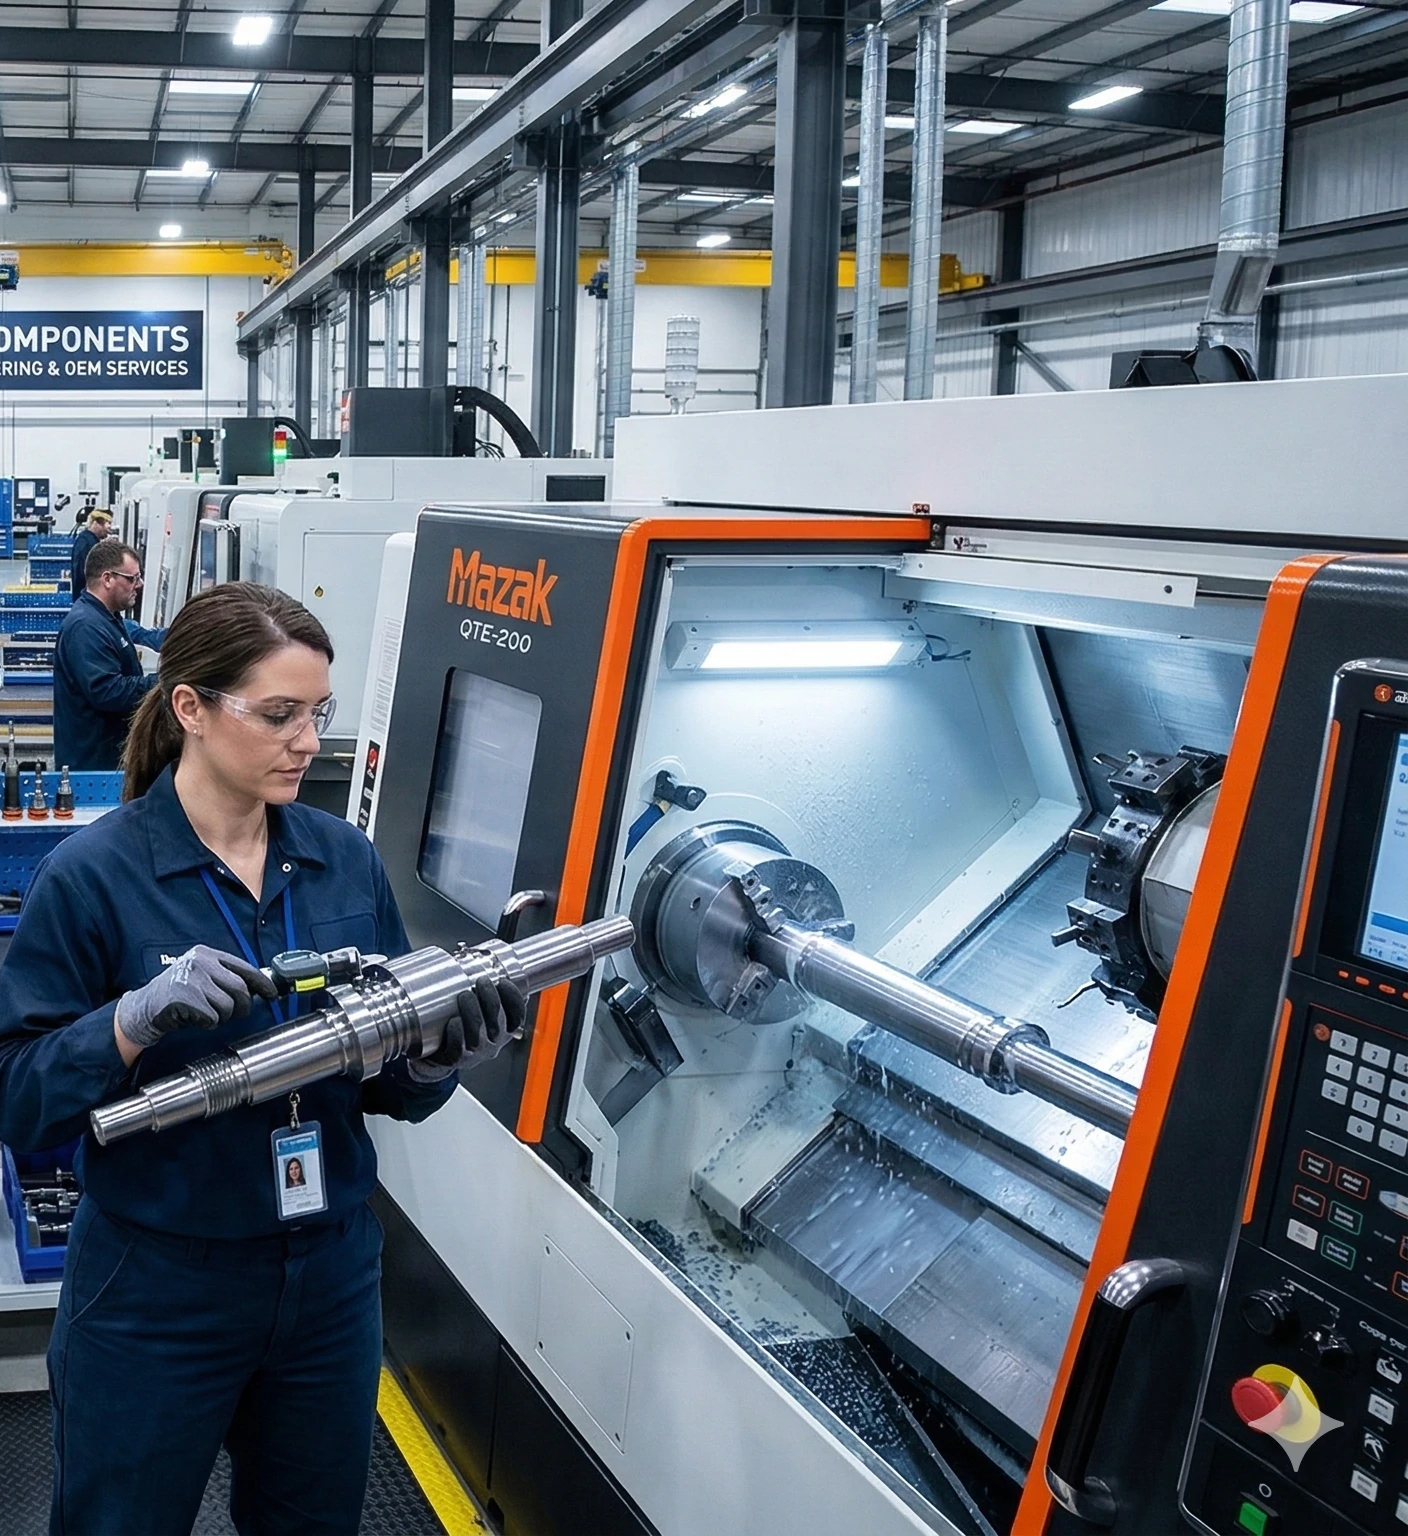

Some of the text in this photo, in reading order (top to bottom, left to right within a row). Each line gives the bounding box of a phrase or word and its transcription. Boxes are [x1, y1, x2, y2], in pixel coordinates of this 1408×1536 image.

[47, 360, 61, 377] &
[65, 360, 102, 377] OEM
[106, 360, 189, 377] SERVICES
[447, 547, 559, 626] Mazak
[459, 618, 532, 654] QTE-200
